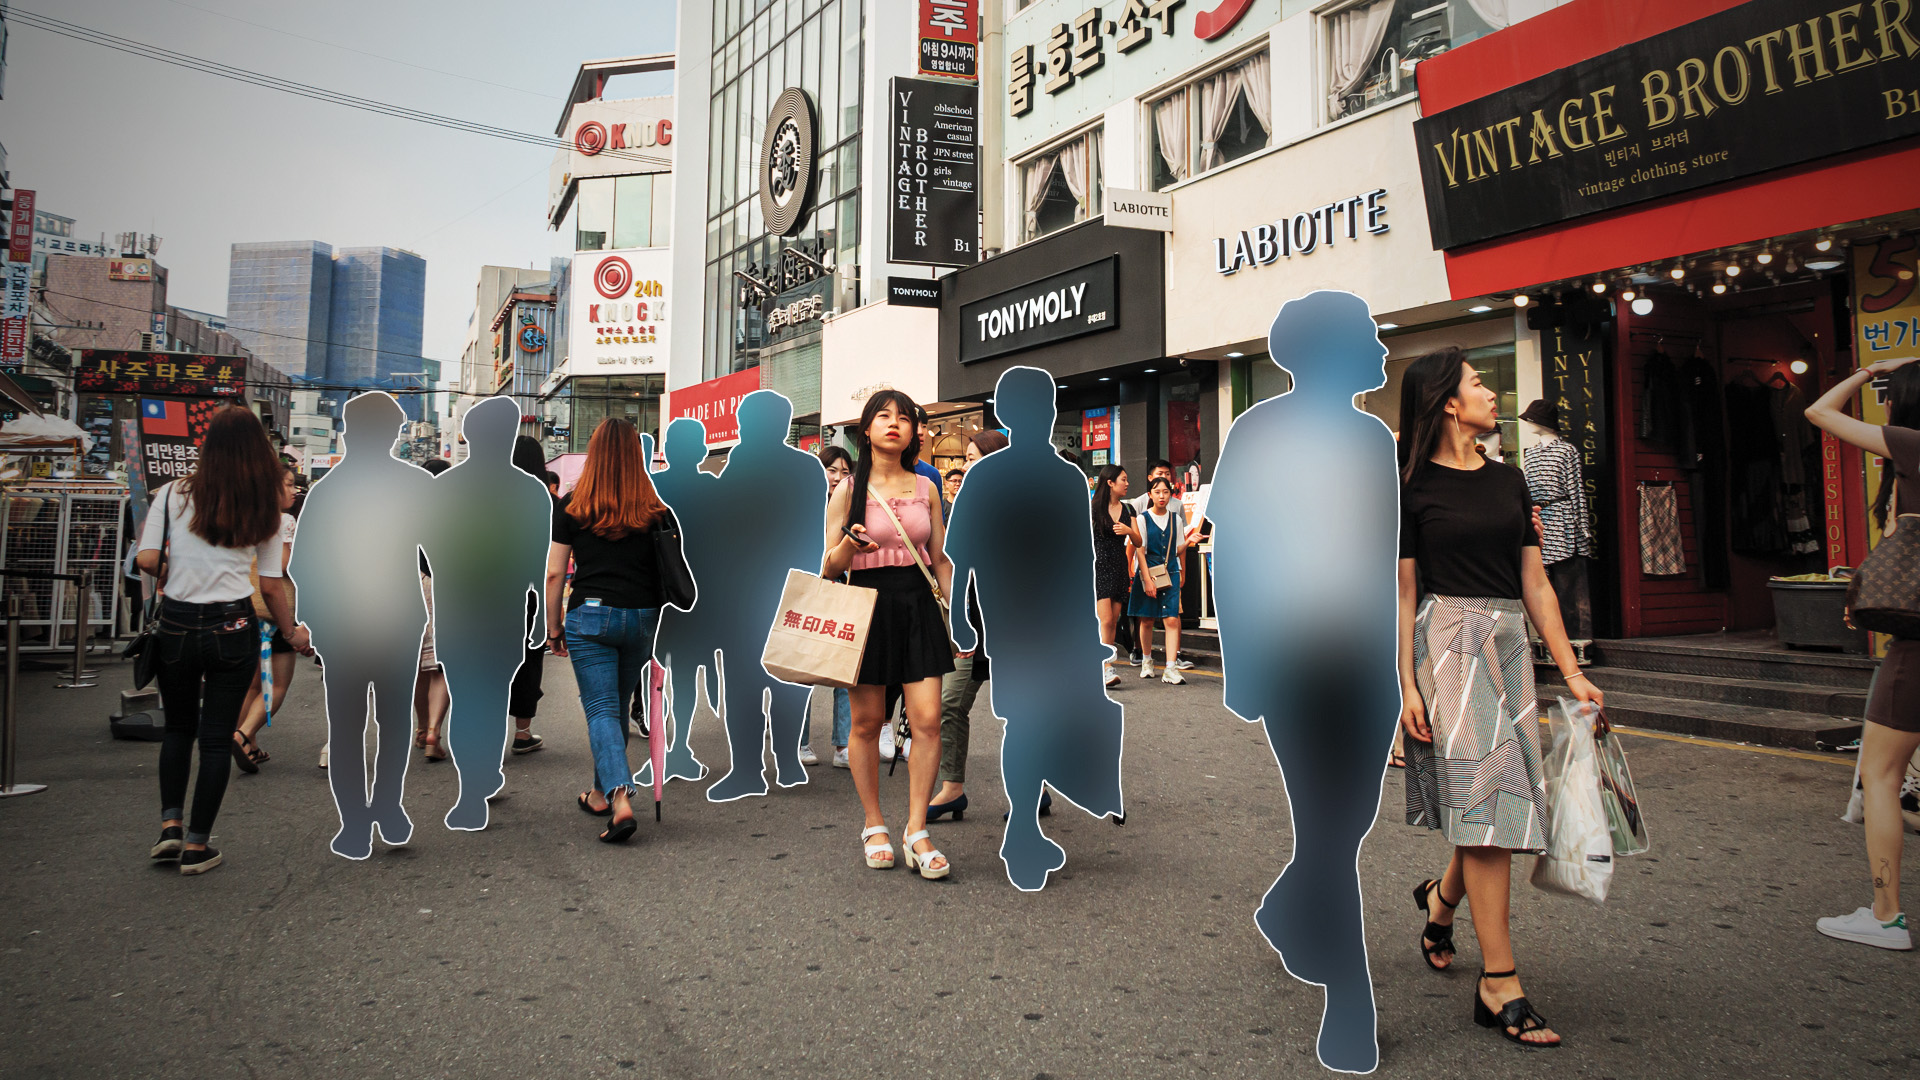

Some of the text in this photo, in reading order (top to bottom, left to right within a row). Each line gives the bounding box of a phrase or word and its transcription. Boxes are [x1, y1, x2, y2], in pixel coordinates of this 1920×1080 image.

[931, 59, 965, 73] 영업합니다
[1434, 0, 1920, 188] VINTAGE BROTHER
[1881, 88, 1920, 120] B1
[933, 120, 973, 133] American
[946, 133, 972, 142] casual
[897, 91, 913, 211] VINTAGE
[933, 147, 974, 160] JPN street
[1604, 128, 1689, 168] 빈티지 브라더
[933, 166, 952, 176] girls
[1578, 149, 1729, 197] vintage clothing store
[914, 128, 928, 247] BROTHER
[942, 177, 973, 190] vintage
[1113, 201, 1169, 218] LABIOTTE
[1212, 188, 1391, 276] LABIOTTE
[954, 238, 971, 252] B1
[634, 279, 663, 298] 24h
[892, 286, 938, 298] TONYMOLY
[589, 301, 665, 323] KNOCK
[977, 282, 1087, 342] TONYMOLY
[96, 359, 207, 384] 사주타로
[714, 399, 725, 418] IN
[782, 610, 856, 642] 無印良品
